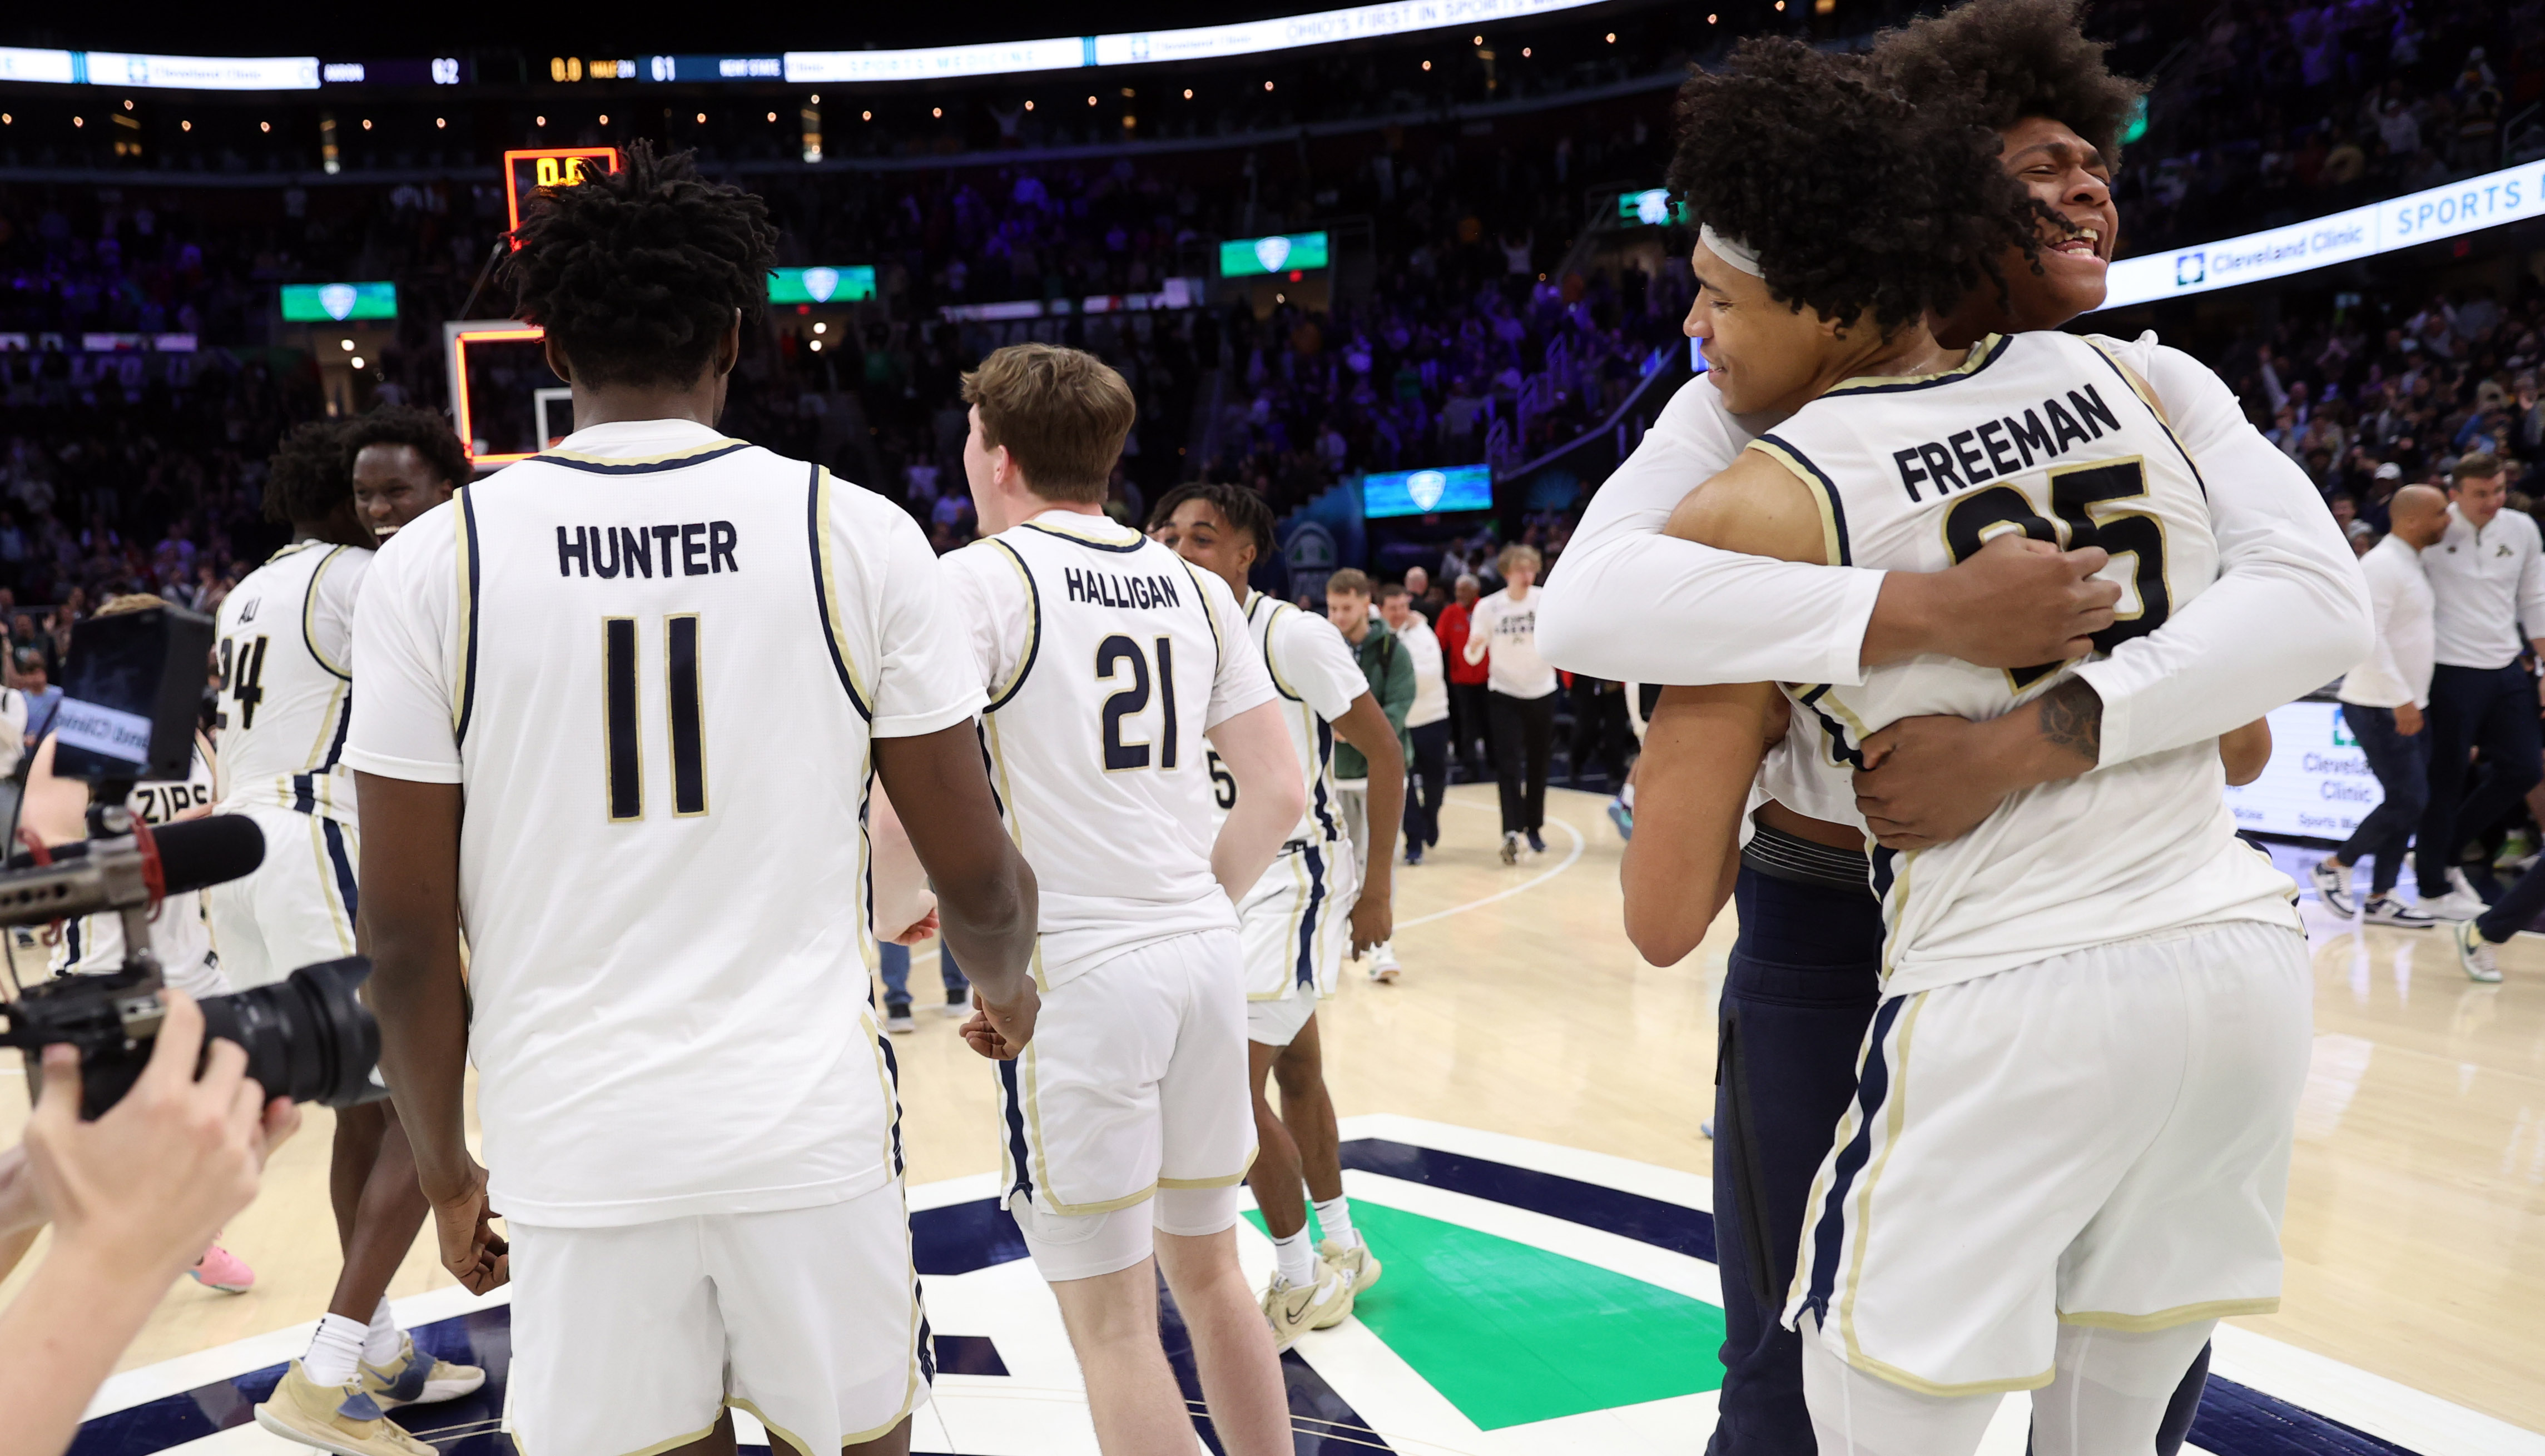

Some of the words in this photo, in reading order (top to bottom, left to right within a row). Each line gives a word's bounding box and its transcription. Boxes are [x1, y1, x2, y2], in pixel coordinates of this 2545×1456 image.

[431, 58, 459, 84] 62
[551, 57, 582, 82] 0.0
[651, 56, 675, 81] 61
[2397, 180, 2521, 236] SPORTS
[2211, 236, 2307, 275] Cleveland
[2310, 223, 2364, 254] Clinic
[1893, 384, 2121, 502] FREEMAN
[557, 520, 738, 579] HUNTER
[1064, 567, 1180, 610] HALLIGAN
[237, 597, 262, 626] ALI
[601, 612, 710, 823] 11
[1094, 632, 1178, 773] 21
[2303, 752, 2373, 775] Clevela
[2320, 781, 2373, 803] Clinic
[2298, 811, 2336, 828] Sports
